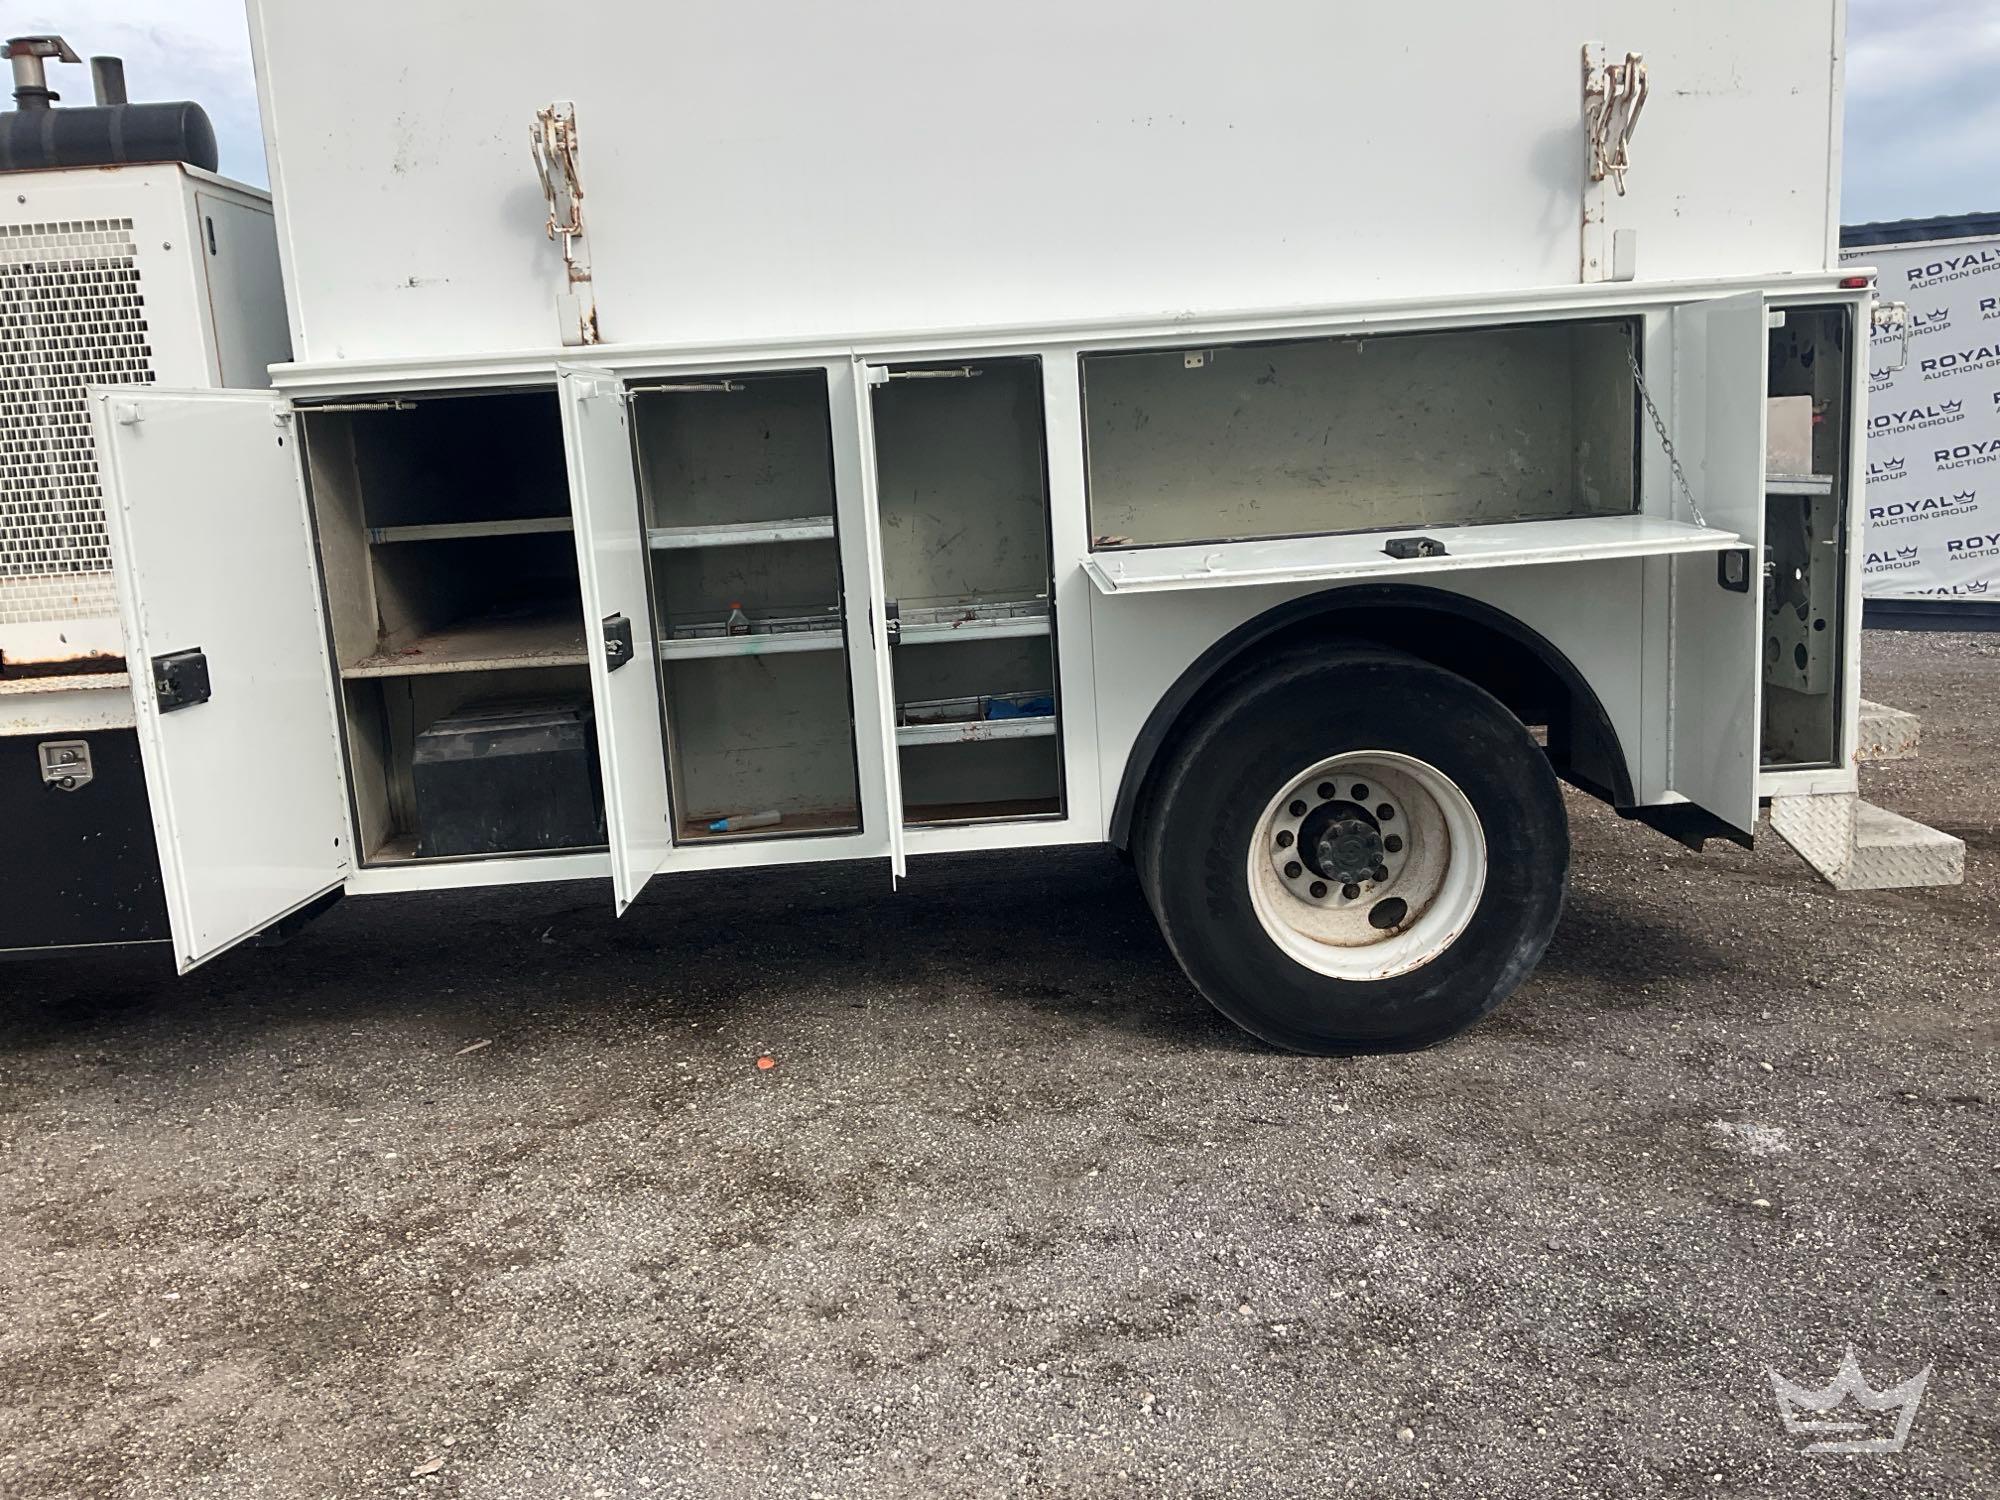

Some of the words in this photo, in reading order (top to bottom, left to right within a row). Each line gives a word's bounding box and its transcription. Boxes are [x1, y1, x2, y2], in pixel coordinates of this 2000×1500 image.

[1907, 251, 1995, 281] ROYAL
[1910, 271, 1970, 291] AUCTION
[1972, 263, 2000, 275] GRO
[1871, 334, 1903, 346] TION
[1923, 363, 1983, 381] AUCTION
[1868, 382, 1894, 392] OUP
[1867, 424, 1916, 439] UCTION
[1918, 414, 1965, 429] GROUP
[1934, 439, 2000, 462] ROYA
[1937, 454, 1997, 471] AUCTION
[1869, 496, 1953, 519] ROYAL
[1872, 513, 1929, 528] AUCTION
[1931, 505, 1978, 518] GROUP
[1947, 533, 2000, 552] ROY
[1950, 547, 2000, 561] AUCTIO
[1876, 560, 1920, 572] GROUP
